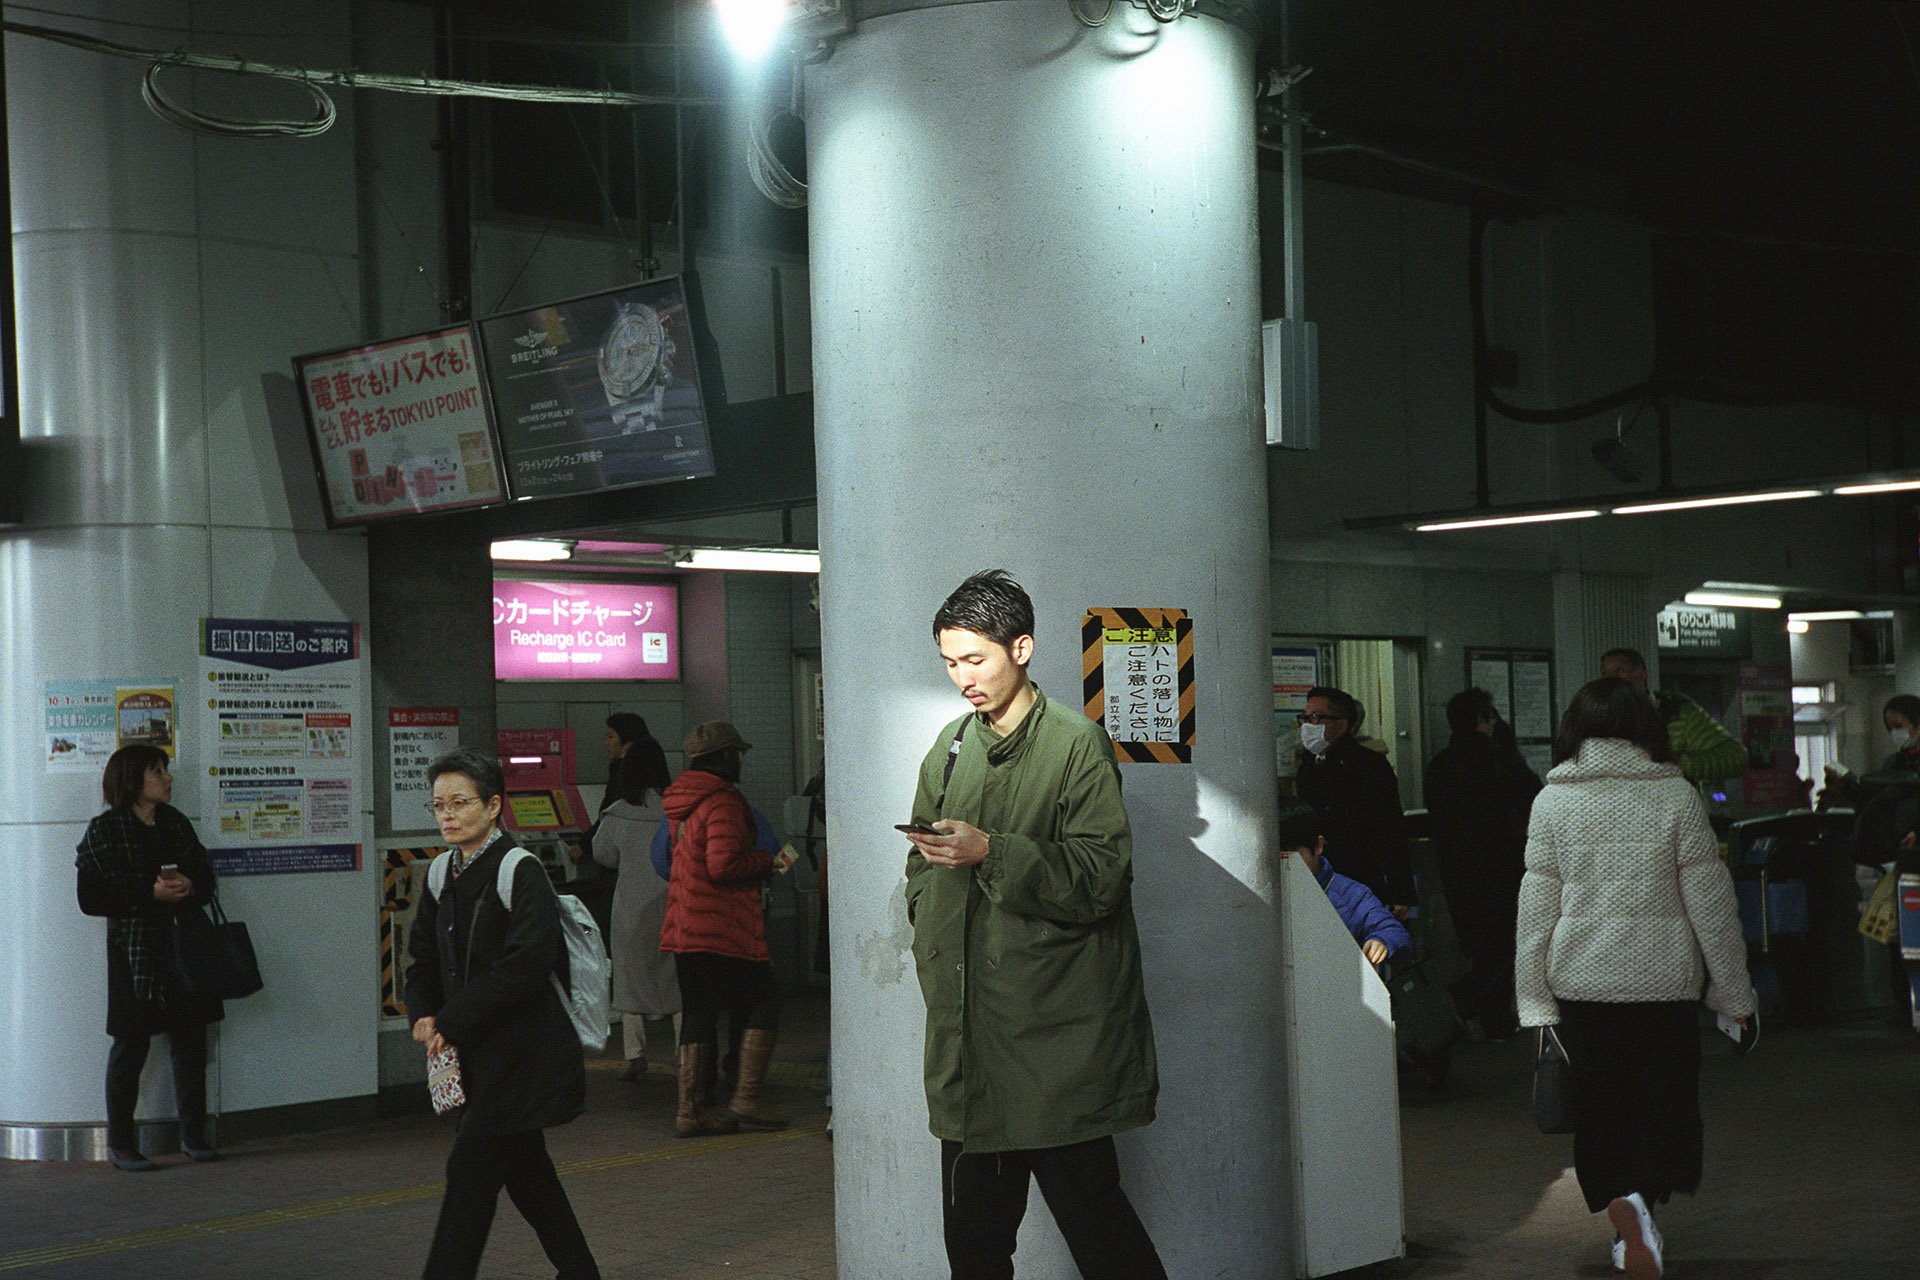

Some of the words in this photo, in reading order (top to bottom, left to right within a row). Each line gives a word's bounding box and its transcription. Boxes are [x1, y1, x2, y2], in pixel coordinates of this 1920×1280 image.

[511, 346, 558, 364] BREITLING
[389, 398, 436, 430] TOKYU
[436, 386, 479, 417] POINT
[212, 629, 349, 654] 振替輸送のご案内
[510, 630, 574, 650] Recharge
[577, 631, 593, 647] IC
[595, 631, 627, 647] Card
[1105, 628, 1174, 643] ご注意
[1127, 645, 1149, 743] ご注意ください
[1151, 645, 1173, 742] ハトの落し物に
